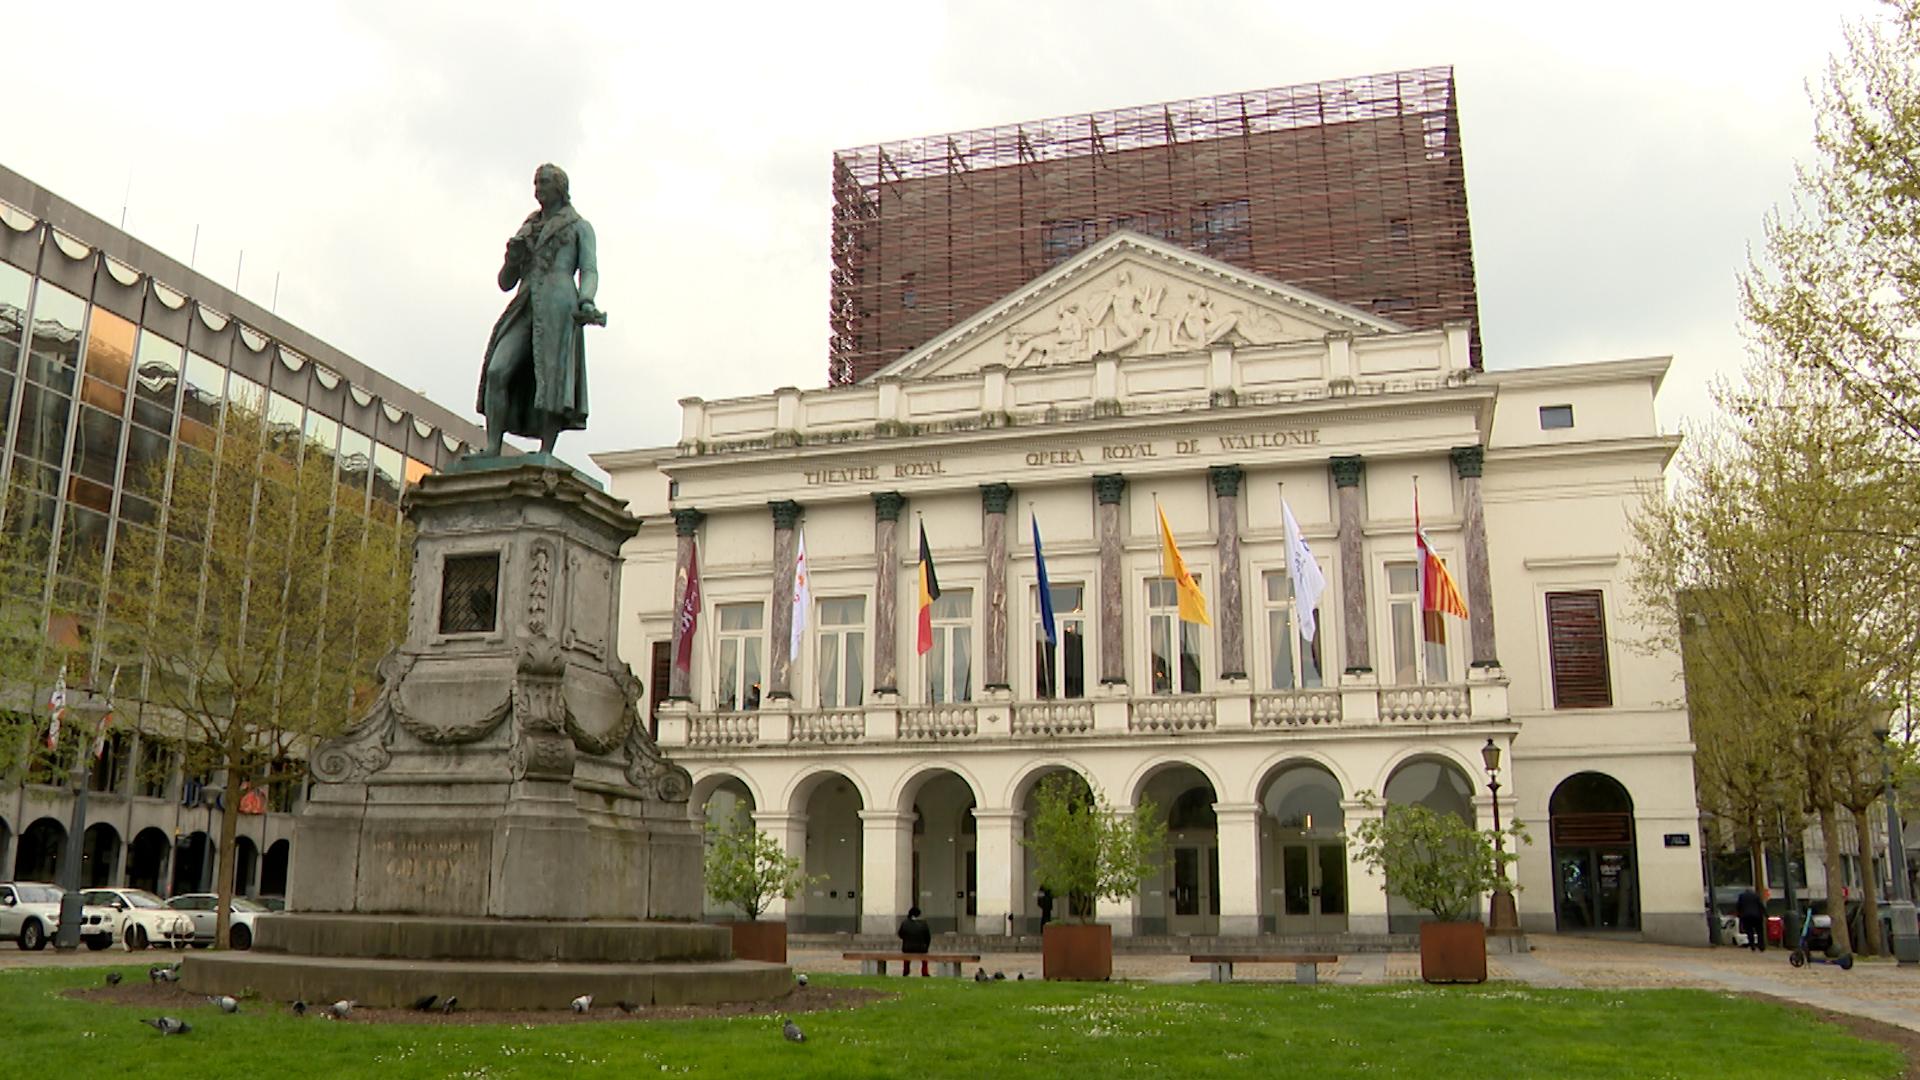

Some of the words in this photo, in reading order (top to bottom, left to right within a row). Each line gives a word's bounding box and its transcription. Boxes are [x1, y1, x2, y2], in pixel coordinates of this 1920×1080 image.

[895, 461, 947, 477] ROYAL
[1026, 448, 1084, 466] OPERA
[1102, 443, 1157, 460] ROYAL
[1176, 439, 1200, 455] DE
[1219, 429, 1321, 449] WALLONIE
